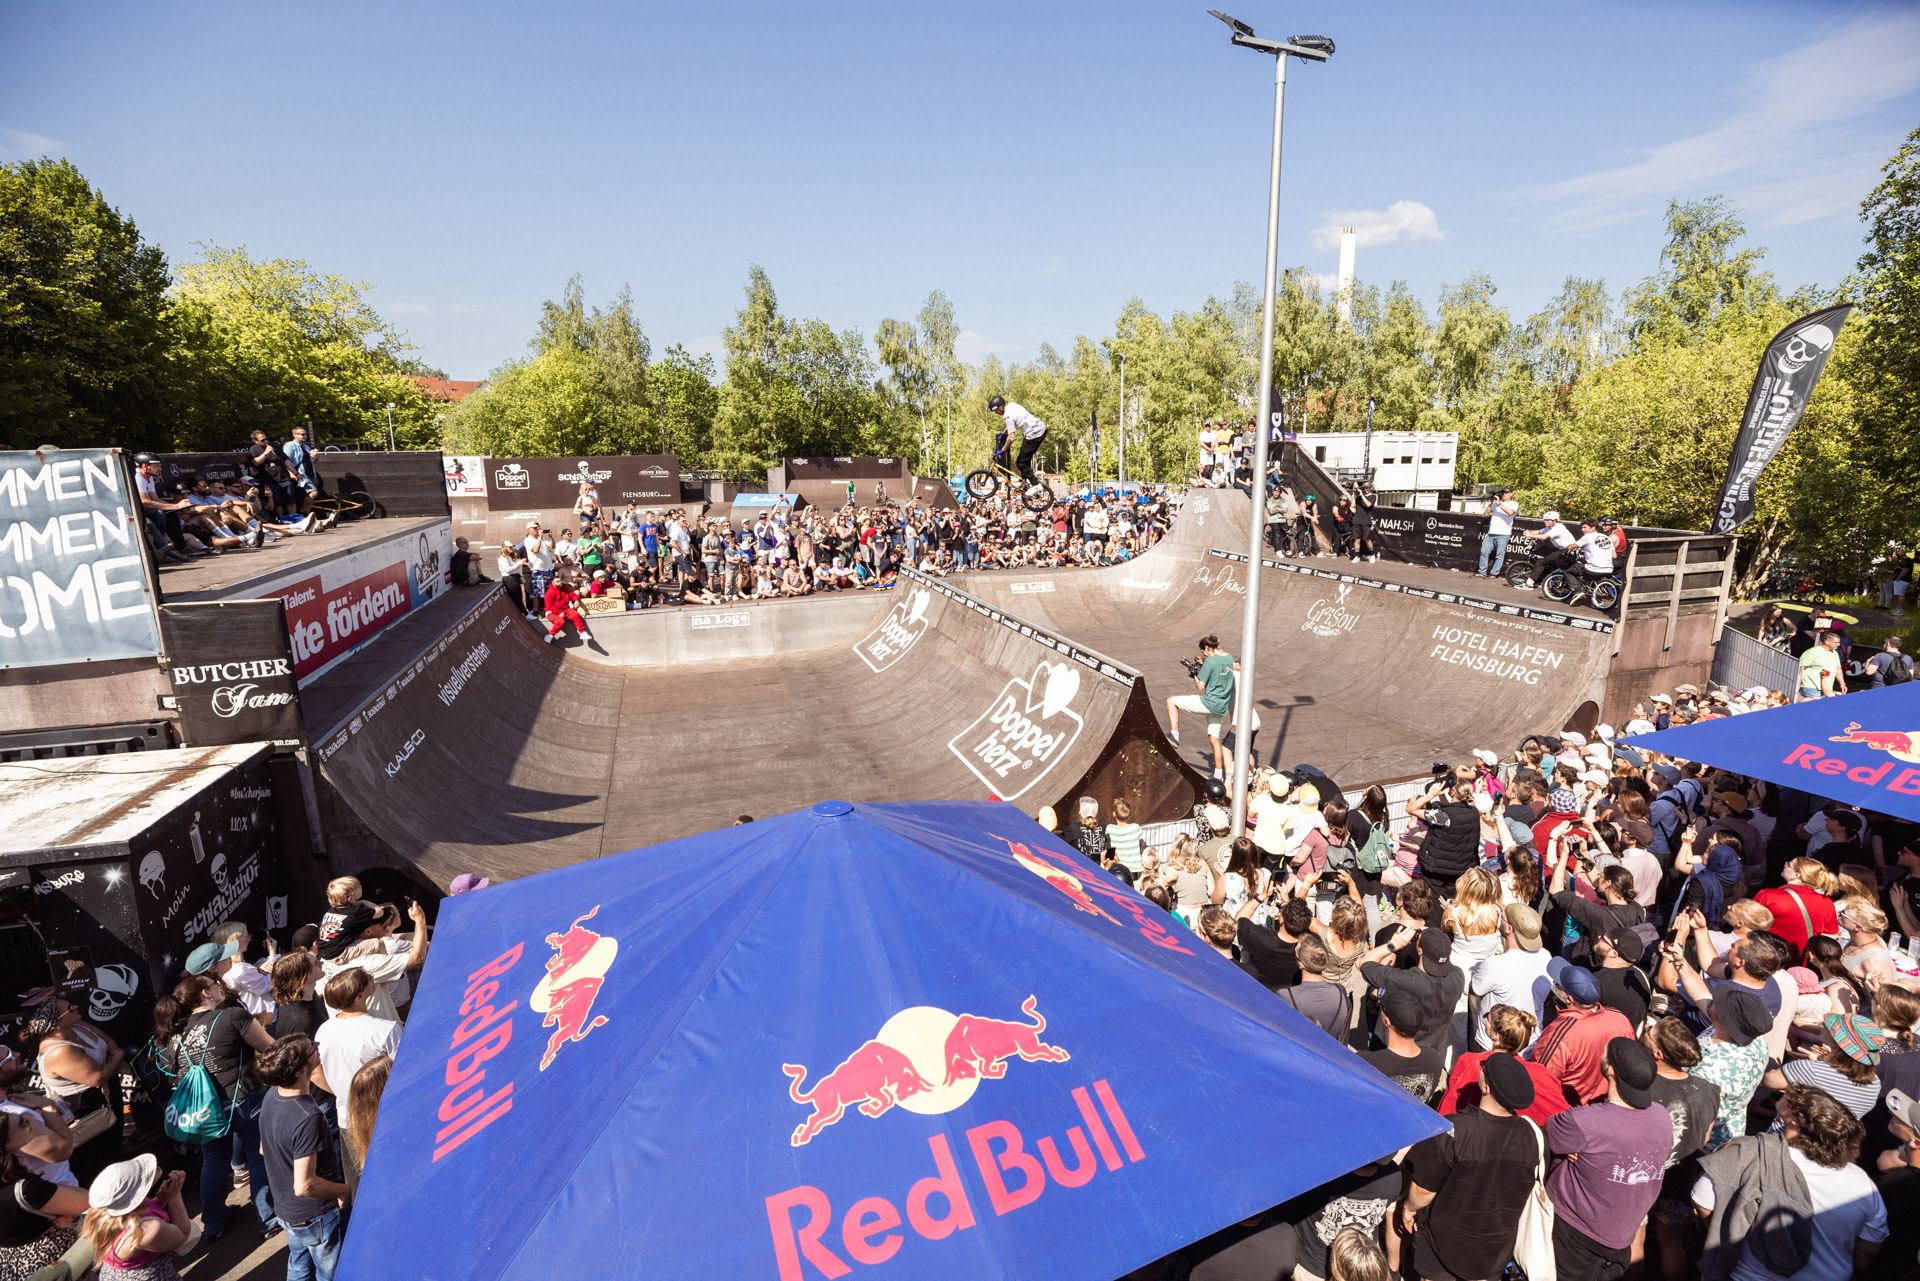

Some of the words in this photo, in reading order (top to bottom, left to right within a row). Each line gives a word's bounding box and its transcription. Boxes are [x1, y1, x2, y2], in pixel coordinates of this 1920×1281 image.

[1379, 518, 1415, 531] NAH.SH
[327, 581, 406, 644] fördern.
[881, 613, 919, 650] Doppel
[1430, 644, 1543, 685] FLENSBURG
[1432, 625, 1488, 652] HOTEL
[1491, 639, 1564, 669] HAFEN
[172, 658, 293, 685] BUTCHER
[437, 641, 491, 707] visuellverstehen
[989, 695, 1066, 763] Doppel
[1782, 743, 1896, 786] Red
[230, 816, 248, 832] 110%
[162, 884, 191, 929] Moin
[1091, 886, 1196, 956] Red
[450, 942, 525, 1049] Red
[432, 1018, 514, 1163] Bull
[765, 1134, 976, 1281] Red
[965, 1079, 1147, 1216] Bull
